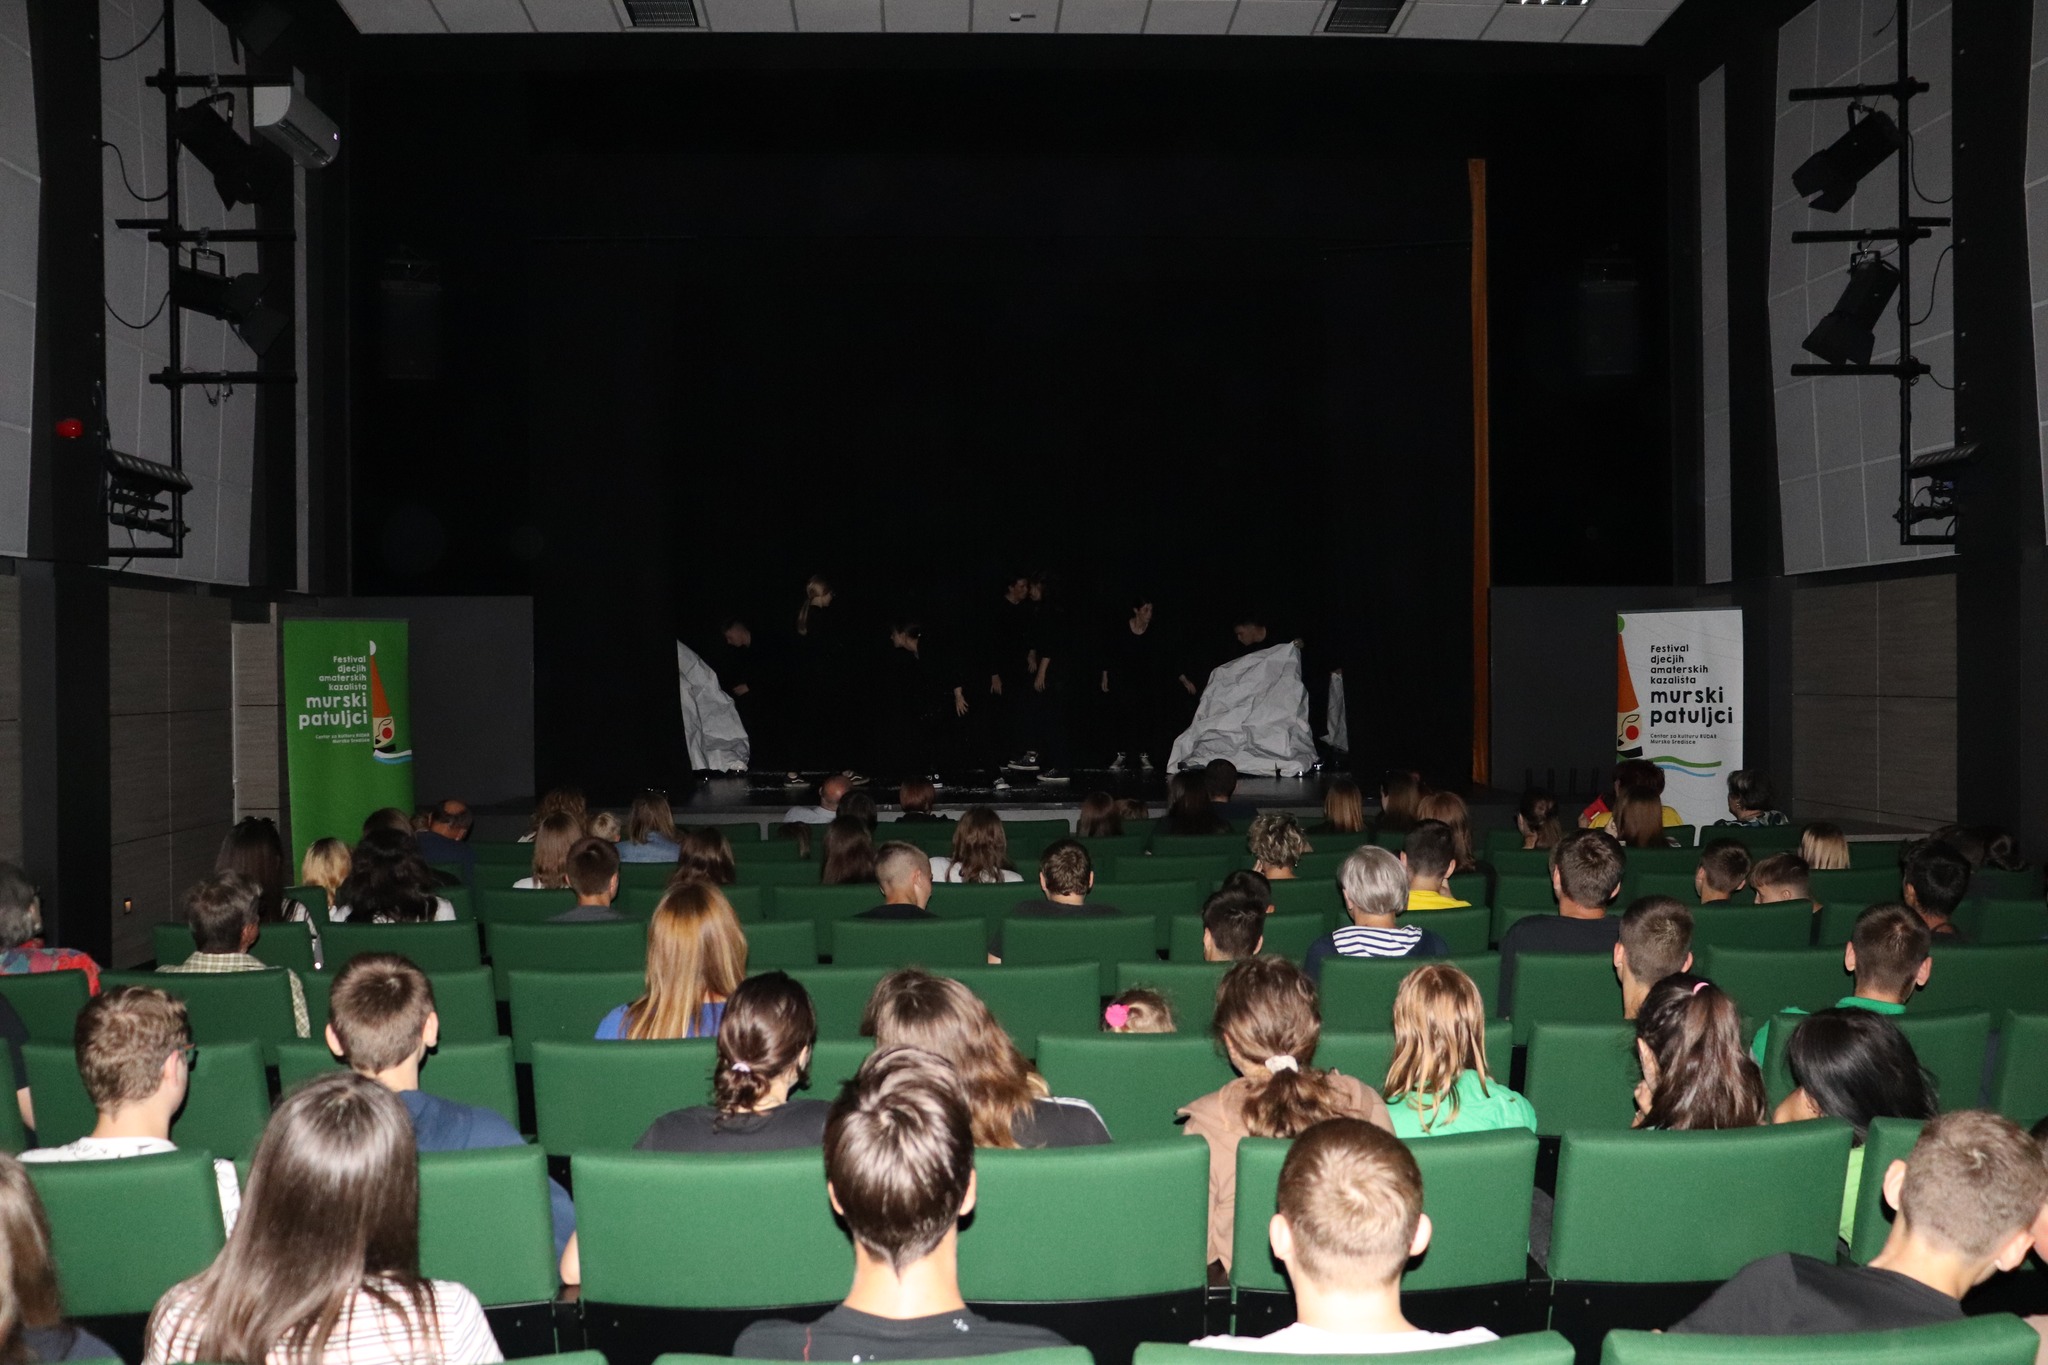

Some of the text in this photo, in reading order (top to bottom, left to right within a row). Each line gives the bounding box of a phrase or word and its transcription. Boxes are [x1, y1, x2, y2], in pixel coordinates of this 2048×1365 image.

[1650, 644, 1689, 653] Festival
[333, 655, 367, 663] Festival
[1650, 665, 1709, 674] amaterskih
[318, 674, 367, 682] amaterskih
[306, 692, 367, 709] murski
[1650, 686, 1724, 704] murski
[299, 710, 368, 730] patuljci
[1650, 707, 1733, 728] patuljci
